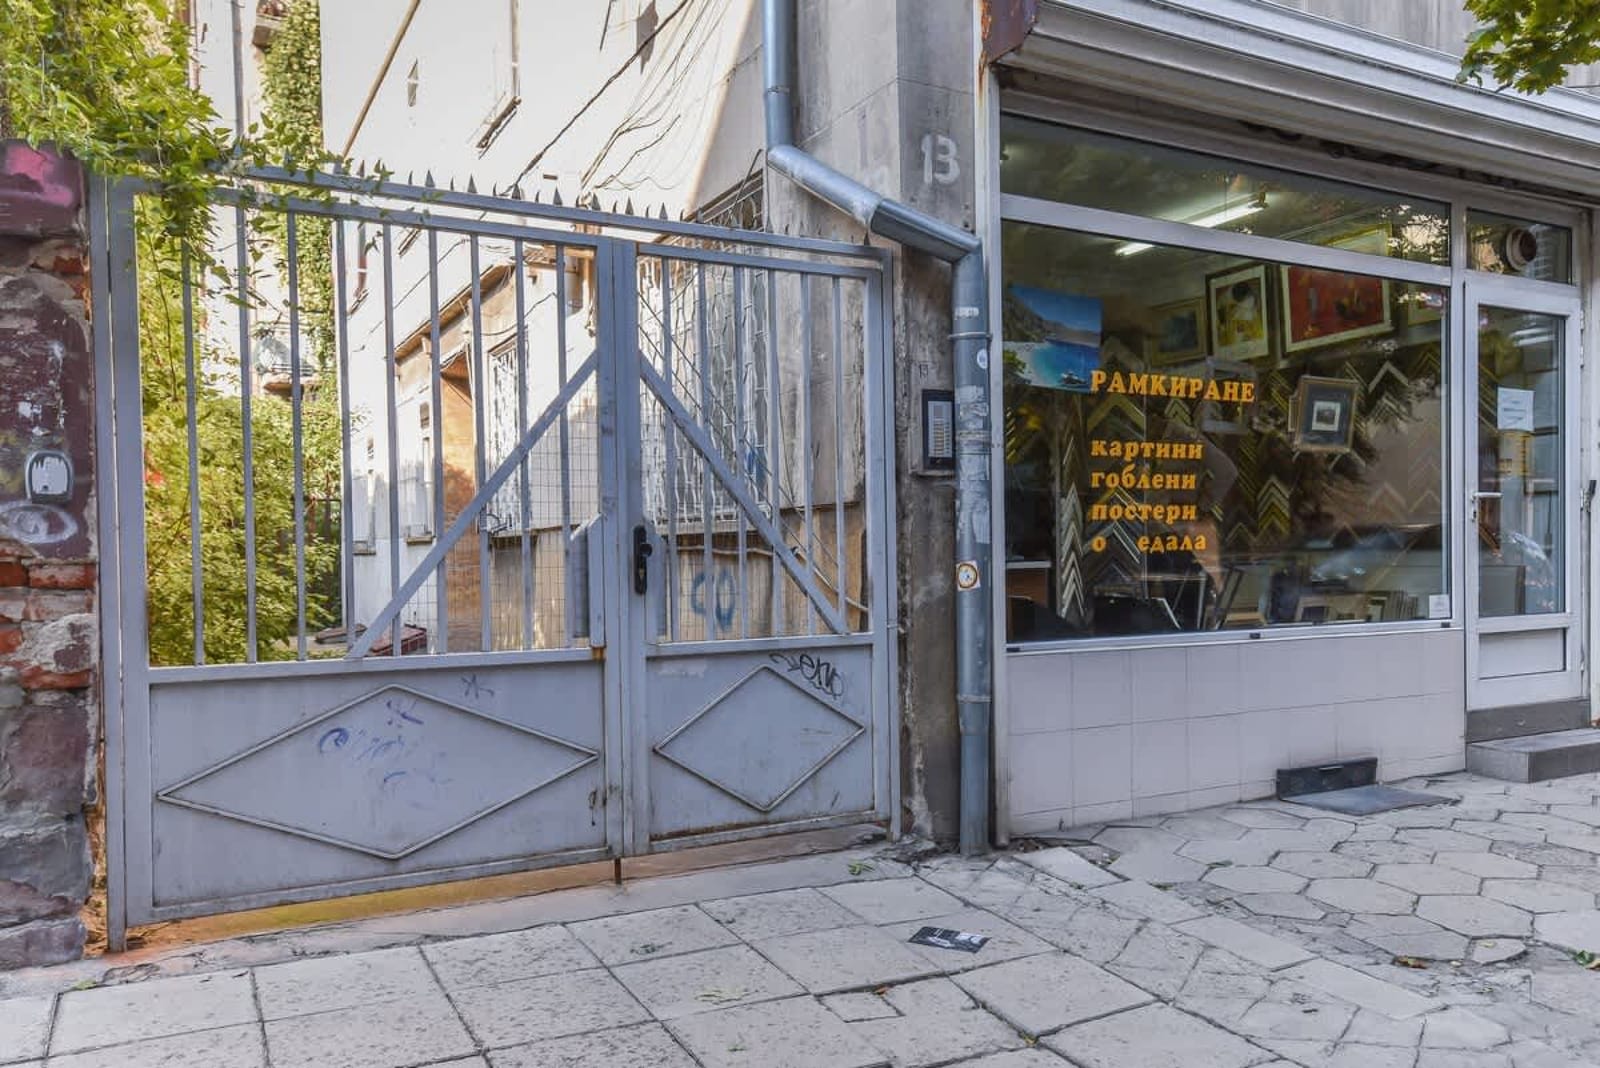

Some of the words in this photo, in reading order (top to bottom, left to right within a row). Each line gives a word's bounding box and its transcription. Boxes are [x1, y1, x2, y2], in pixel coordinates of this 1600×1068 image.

[921, 134, 960, 185] 13
[1090, 370, 1256, 402] РАМКИРАНЕ
[1091, 440, 1204, 462] картини
[1091, 463, 1197, 489] гоблени
[1091, 504, 1197, 525] постери
